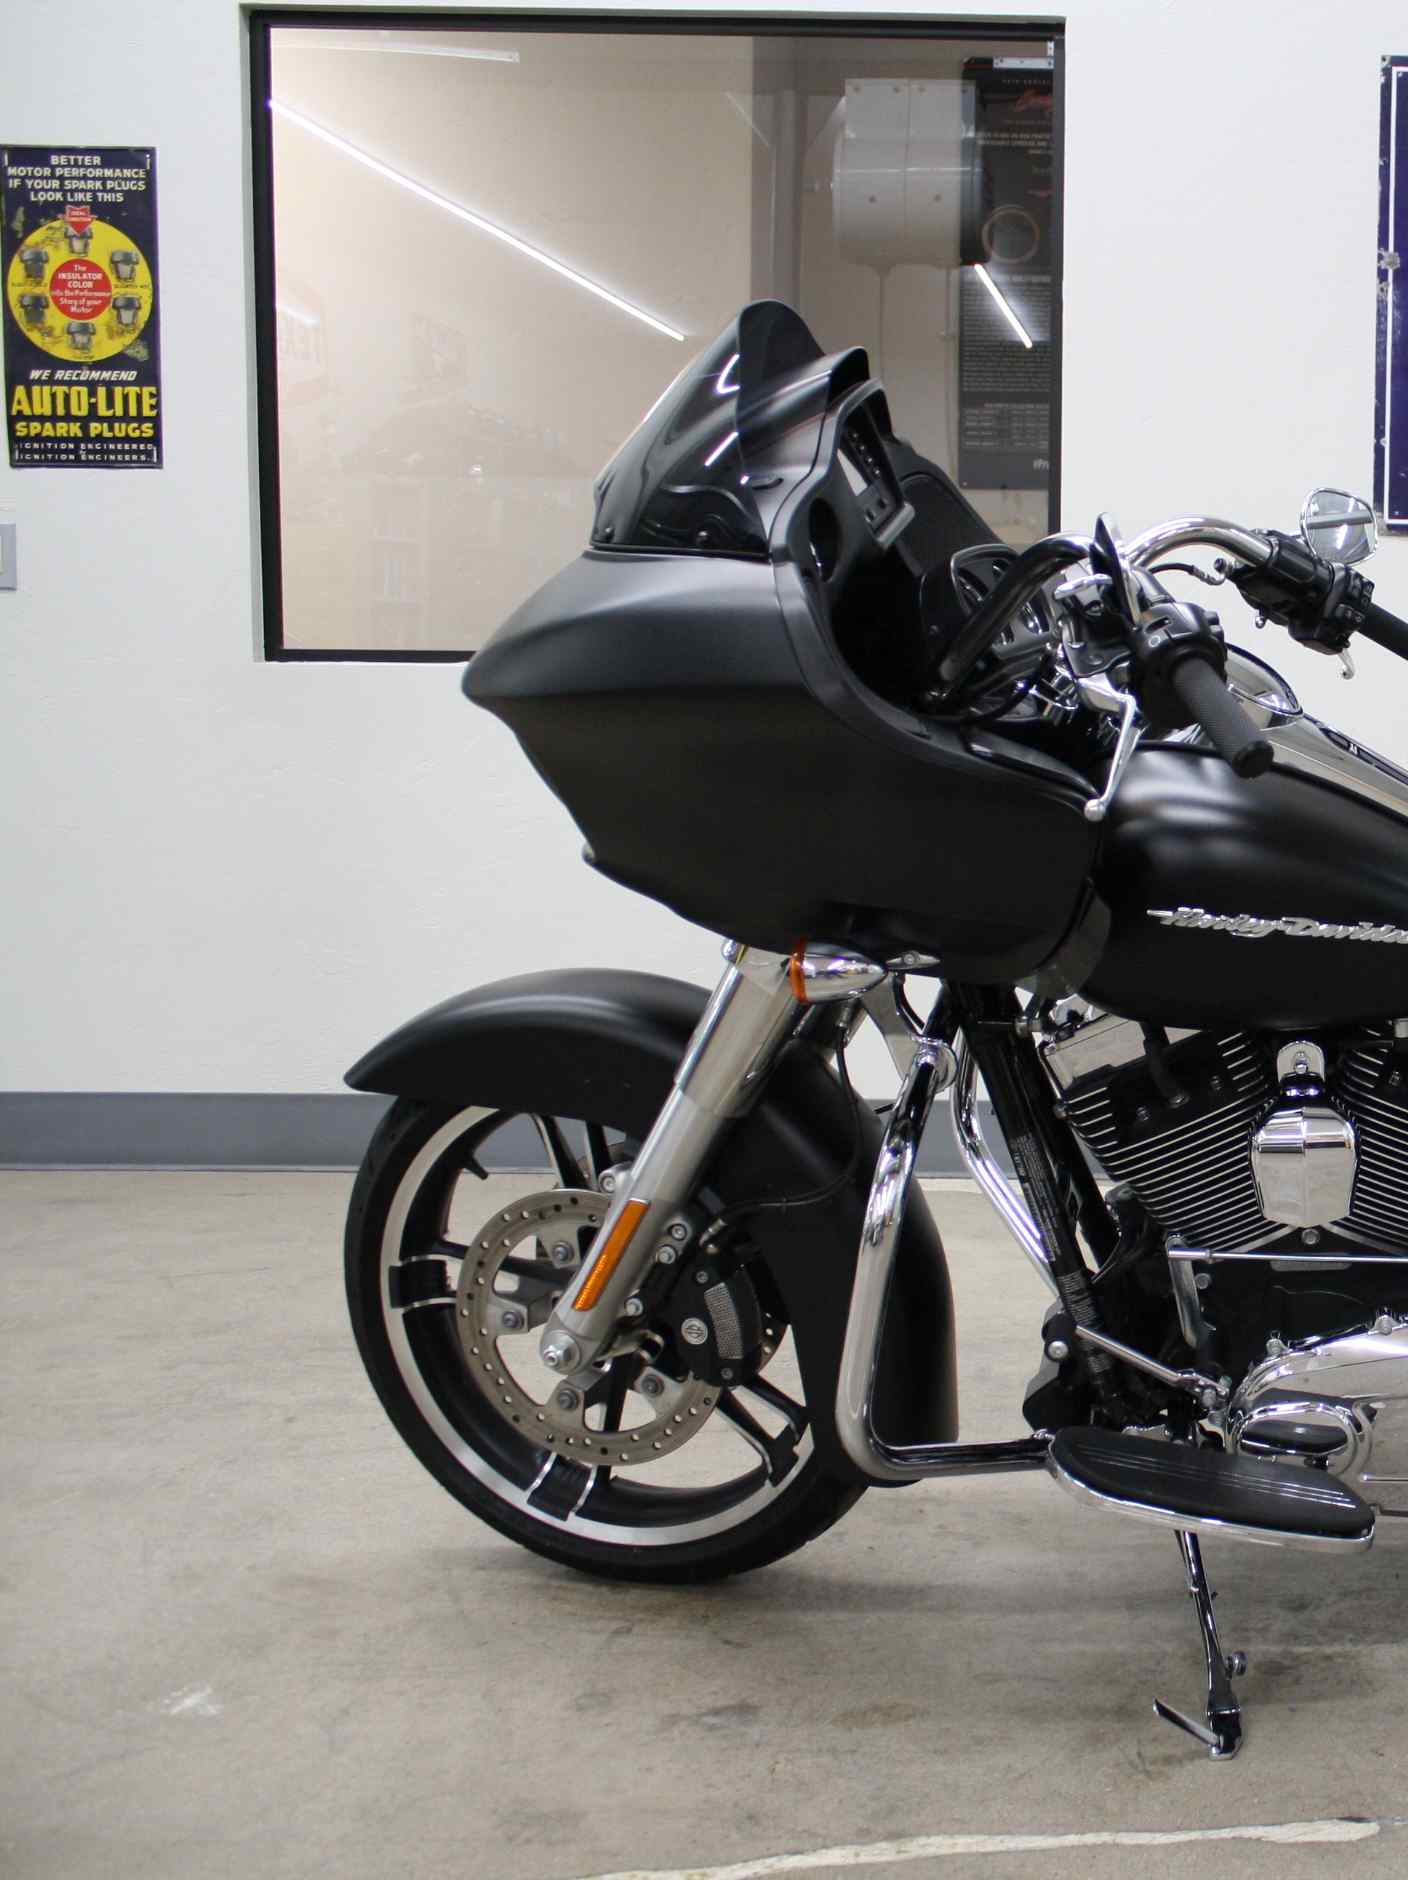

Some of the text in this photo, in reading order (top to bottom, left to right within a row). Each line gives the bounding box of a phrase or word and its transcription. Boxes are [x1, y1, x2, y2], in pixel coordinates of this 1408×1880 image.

[50, 155, 102, 166] BETTER
[8, 167, 147, 178] MOTOR PERFORMANCE
[9, 179, 146, 191] IF YOUR SPARK PLUGS
[30, 191, 124, 202] LOOK LIKE THIS
[58, 272, 103, 280] INSULATOR
[67, 280, 94, 289] COLOR
[29, 369, 138, 381] WE RECOMMEND
[11, 385, 158, 417] AUTO-LITE
[15, 422, 155, 438] SPARK PLUGS
